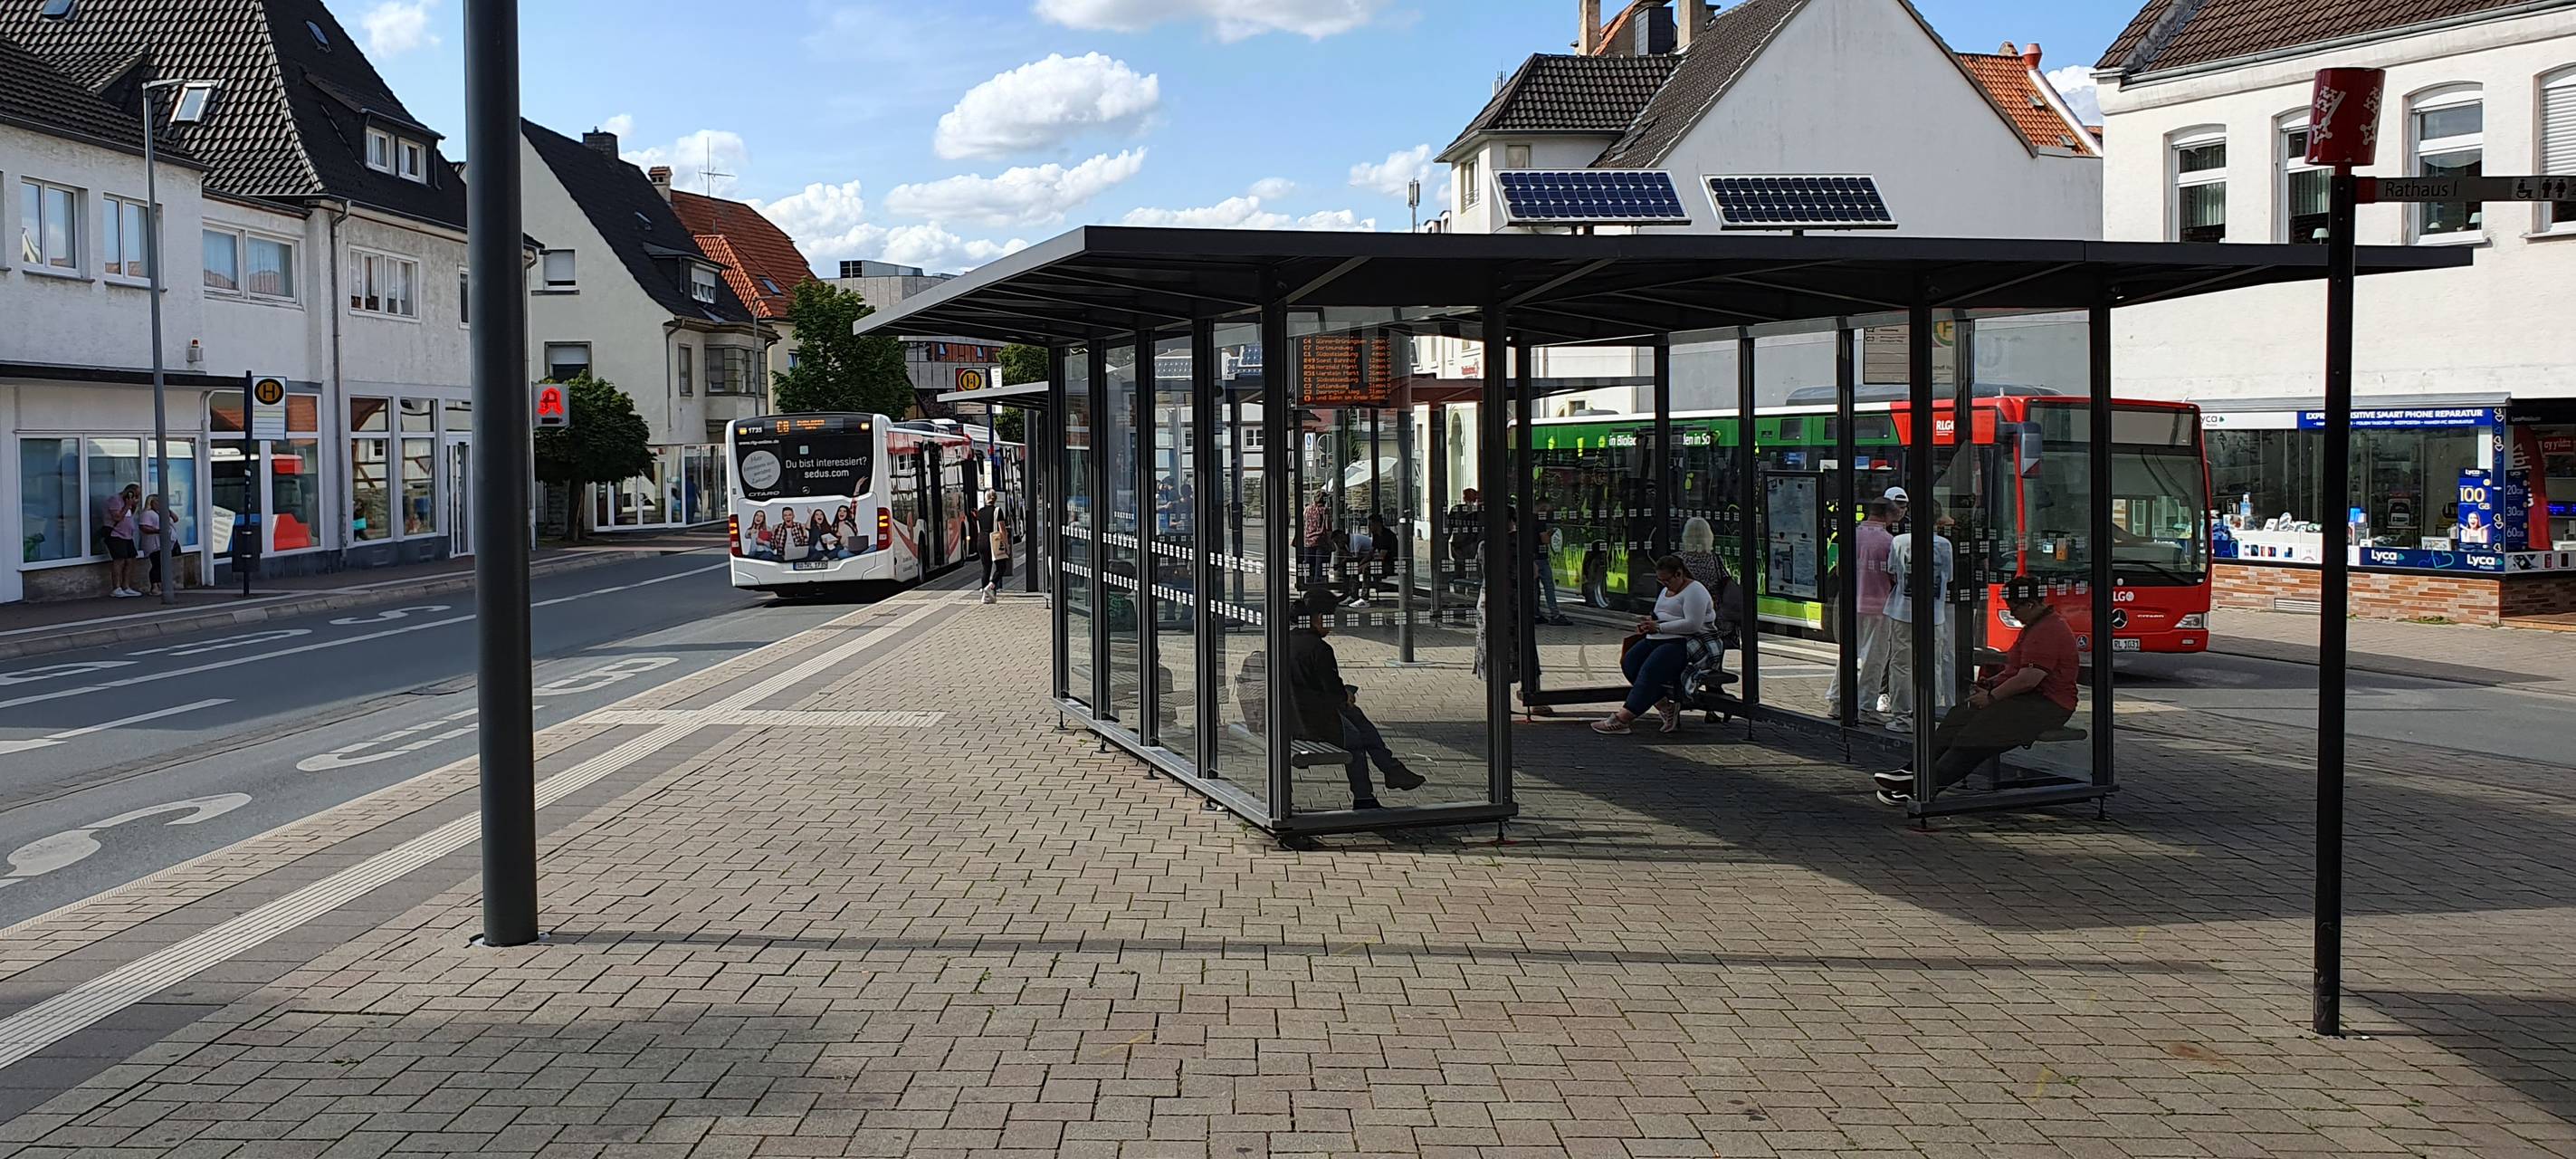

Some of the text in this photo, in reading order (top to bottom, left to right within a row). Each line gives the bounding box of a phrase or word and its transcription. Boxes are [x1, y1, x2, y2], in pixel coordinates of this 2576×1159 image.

[2384, 181, 2448, 197] Rathaus
[2200, 415, 2218, 424] yca
[2305, 412, 2326, 420] EXPR
[2376, 410, 2404, 418] SMART
[2405, 409, 2434, 417] PHONE
[2435, 408, 2484, 417] REPARATUR
[1608, 435, 1617, 445] in
[785, 459, 797, 469] Du
[798, 458, 815, 468] bist
[816, 456, 867, 467] interessiert?
[804, 469, 849, 479] sedus.com
[2458, 486, 2485, 503] 100
[2477, 502, 2491, 511] GB
[2371, 549, 2398, 562] Lyca
[2466, 554, 2495, 567] Lyca
